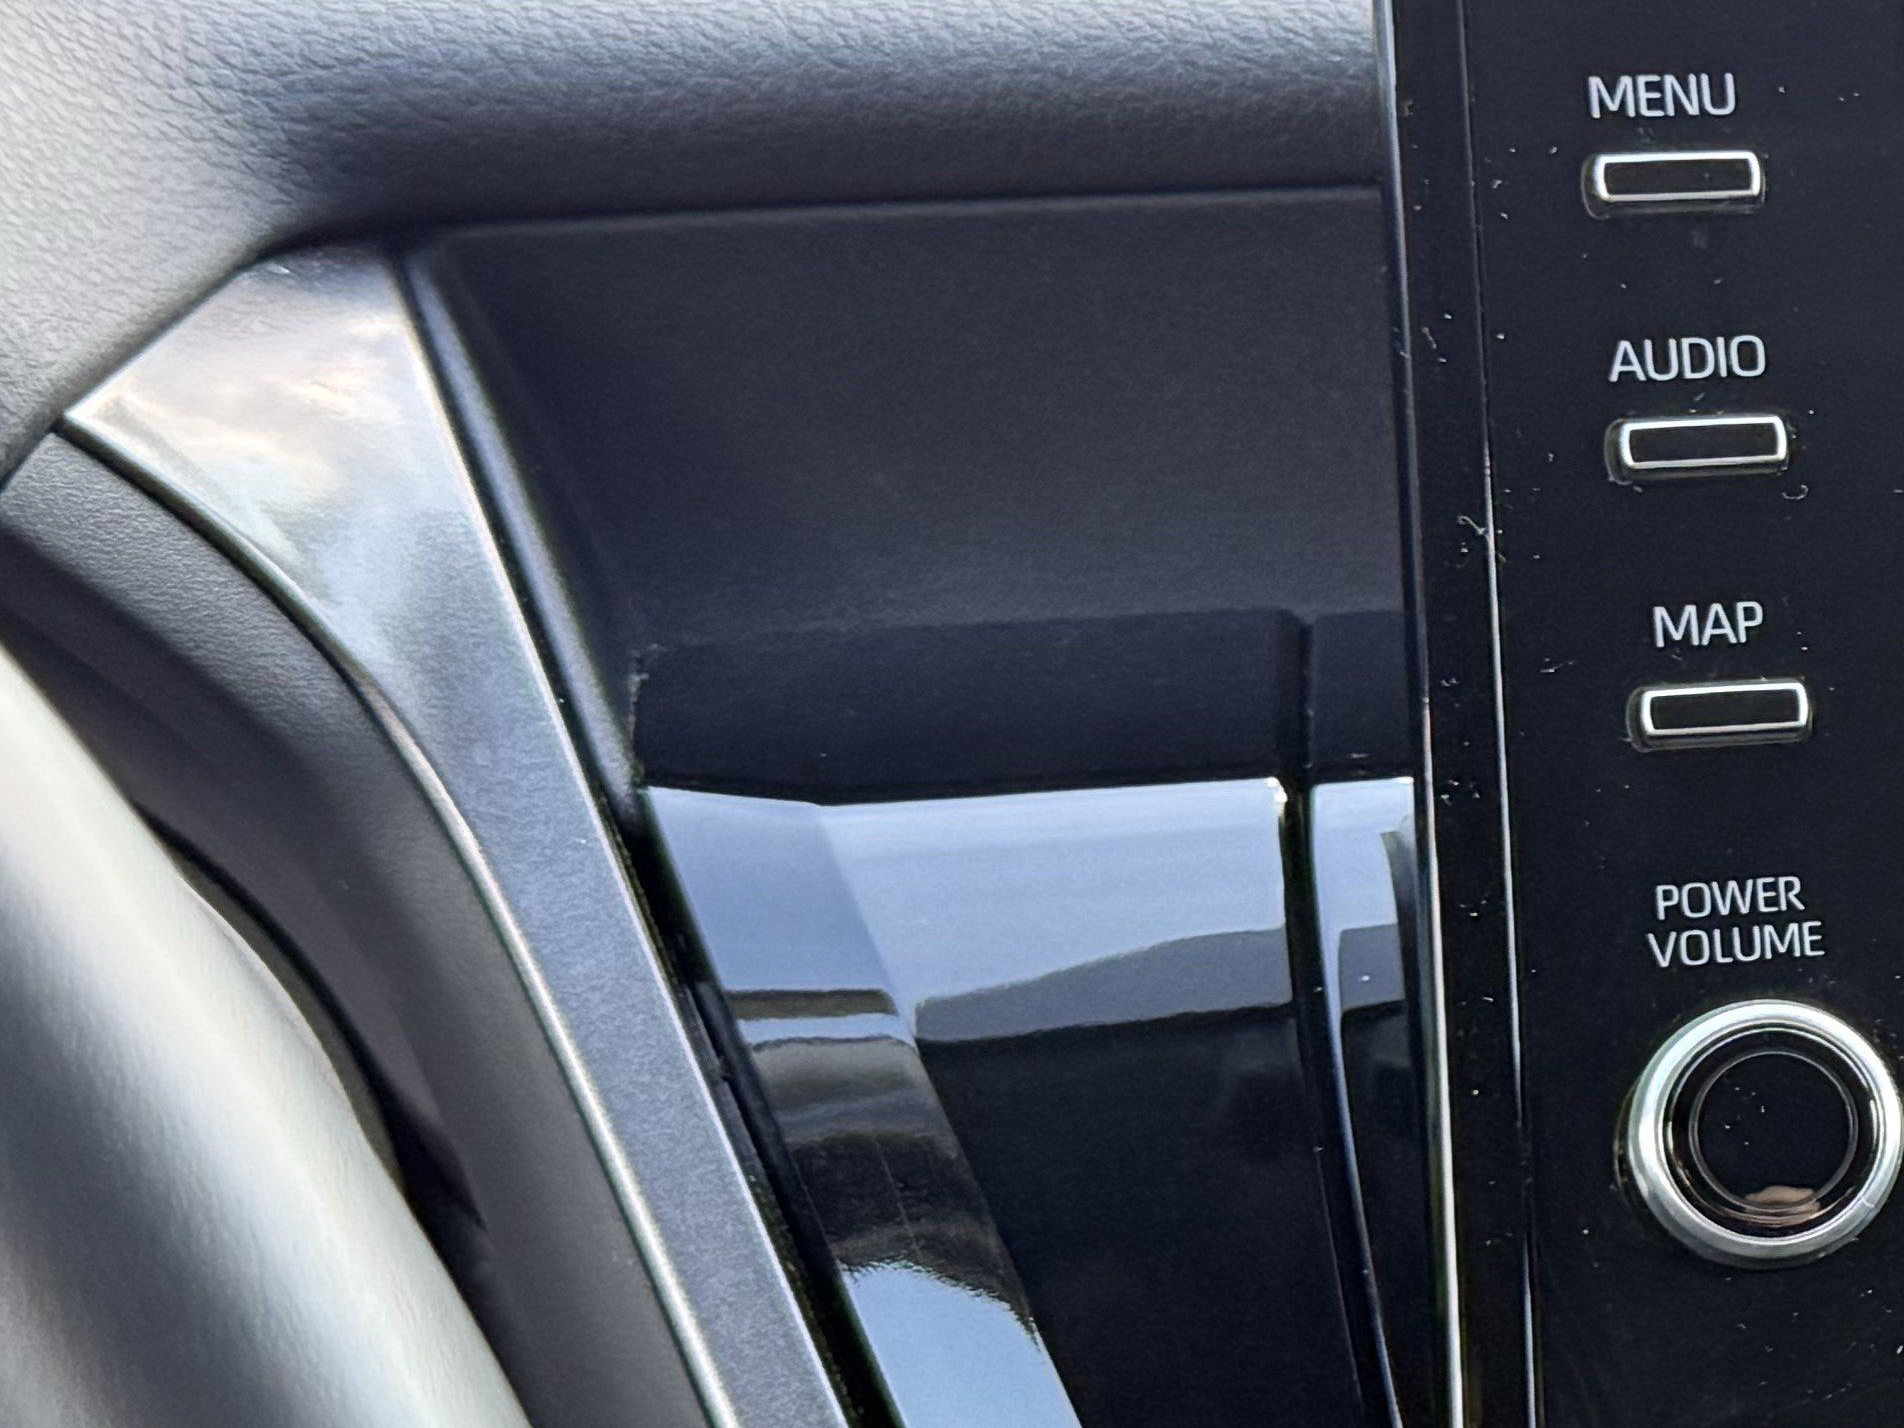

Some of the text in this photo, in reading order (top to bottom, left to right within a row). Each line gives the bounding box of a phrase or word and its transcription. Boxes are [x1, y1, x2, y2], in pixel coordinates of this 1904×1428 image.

[1588, 72, 1736, 119] MENU
[1609, 334, 1766, 383] AUDIO
[1653, 601, 1764, 648] MAP
[1655, 875, 1805, 921] POWER
[1647, 920, 1826, 968] VOLUME
